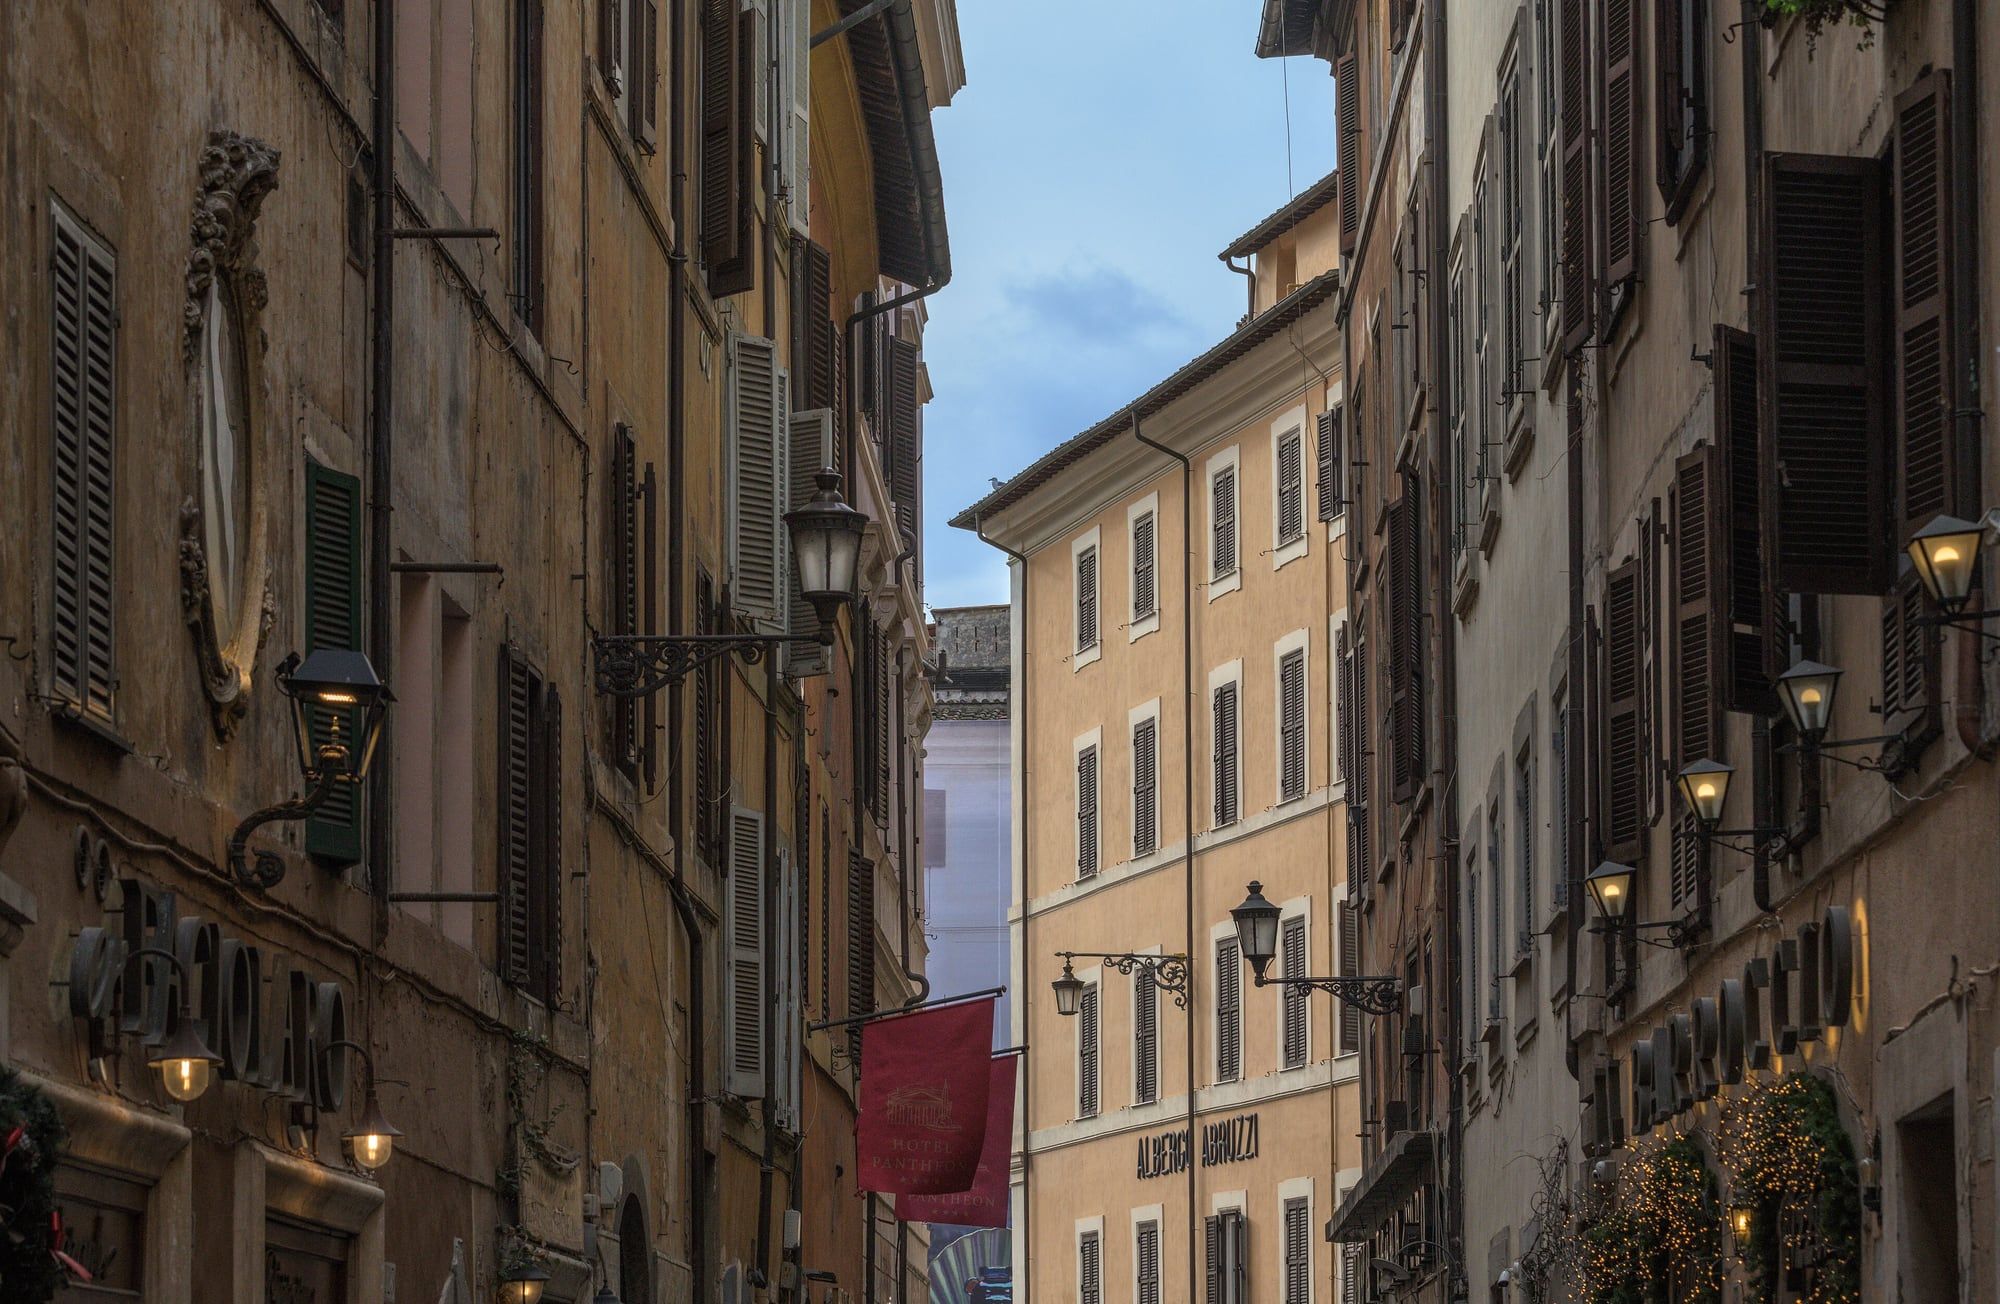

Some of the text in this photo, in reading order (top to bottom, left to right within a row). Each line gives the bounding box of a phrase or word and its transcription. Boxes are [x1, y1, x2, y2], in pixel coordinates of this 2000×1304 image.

[1631, 905, 1852, 1136] BARROCCIO
[891, 1138, 953, 1154] HOTEL
[1202, 1112, 1259, 1168] ABRUZZI
[872, 1155, 969, 1172] PANTHEON
[907, 1192, 997, 1208] PANTHEON
